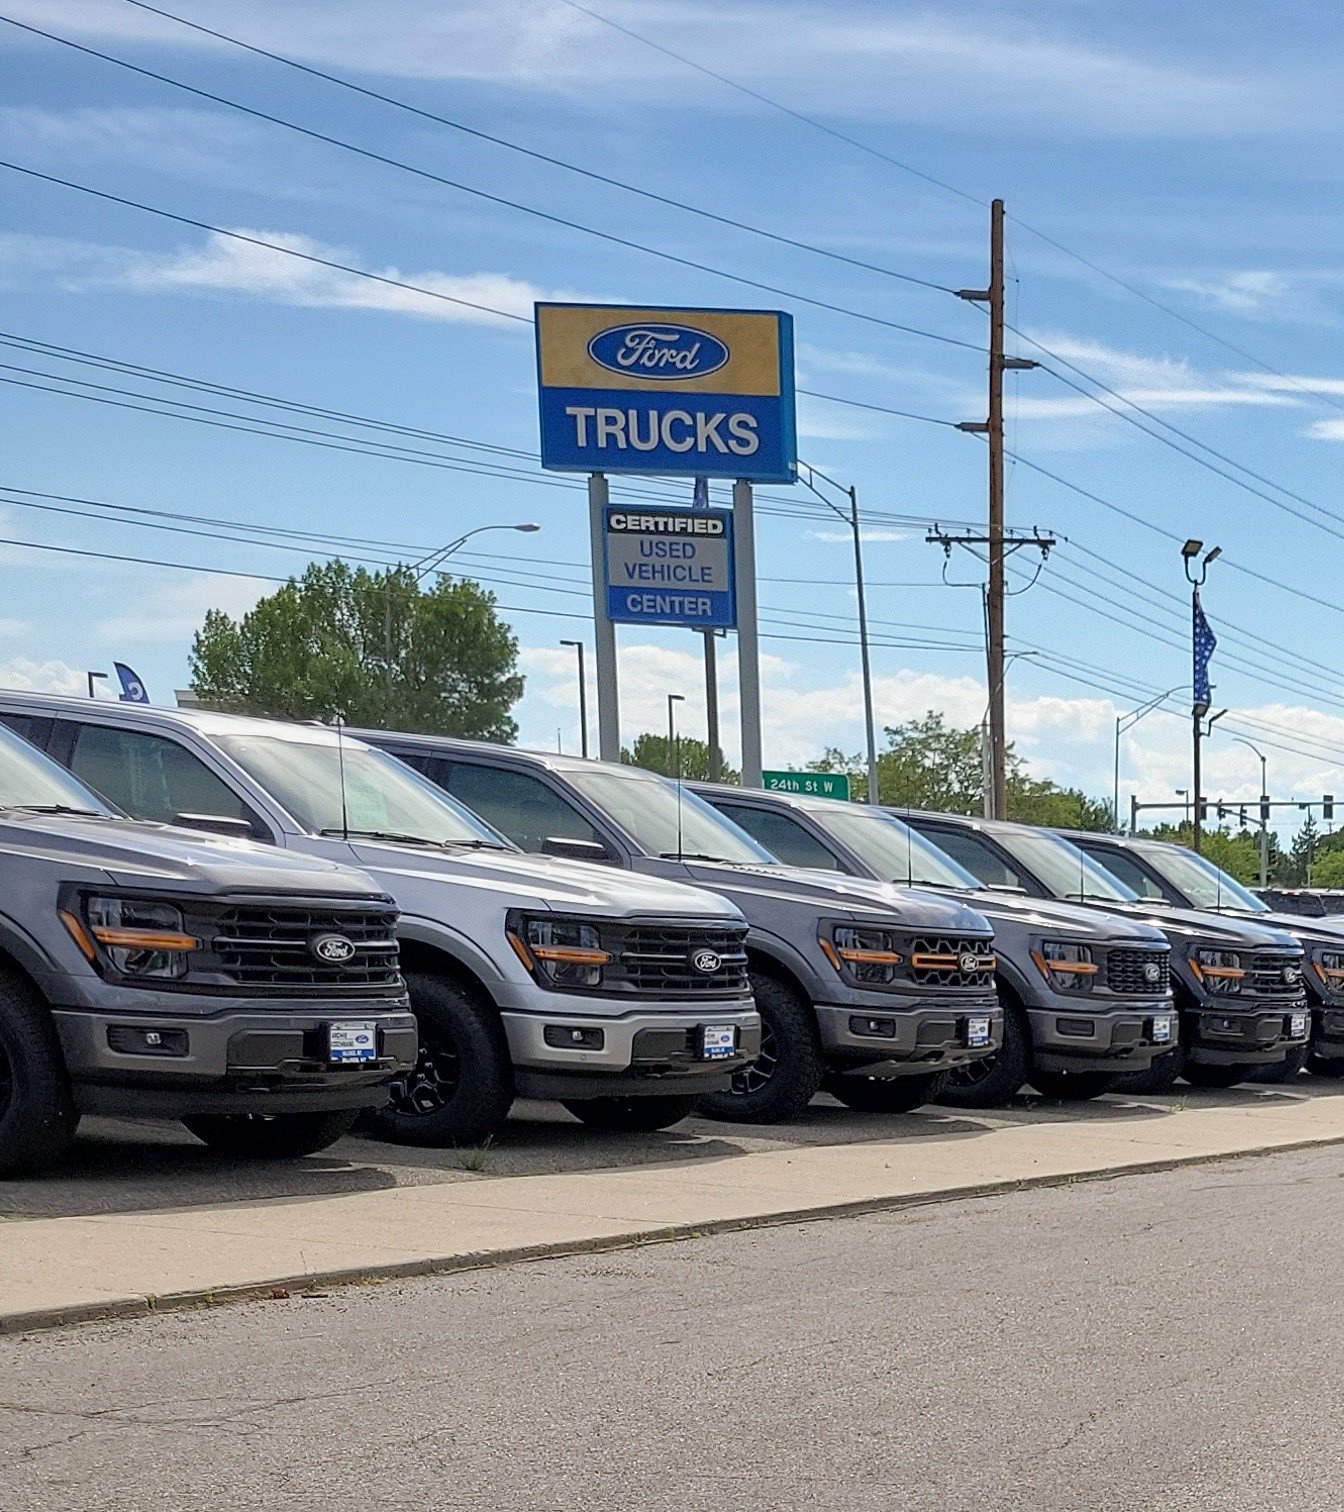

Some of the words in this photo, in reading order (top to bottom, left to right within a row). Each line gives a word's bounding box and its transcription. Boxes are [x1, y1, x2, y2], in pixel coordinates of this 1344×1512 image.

[616, 330, 702, 371] Ford
[566, 406, 760, 456] TRUCKS
[609, 514, 724, 535] CERTIFIED
[639, 540, 696, 560] USED
[624, 562, 713, 584] VEHICLE
[626, 594, 712, 617] CENTER
[770, 779, 799, 791] 24th
[805, 780, 818, 792] St
[823, 781, 833, 793] W
[324, 941, 349, 957] Ford
[700, 955, 717, 969] Ford
